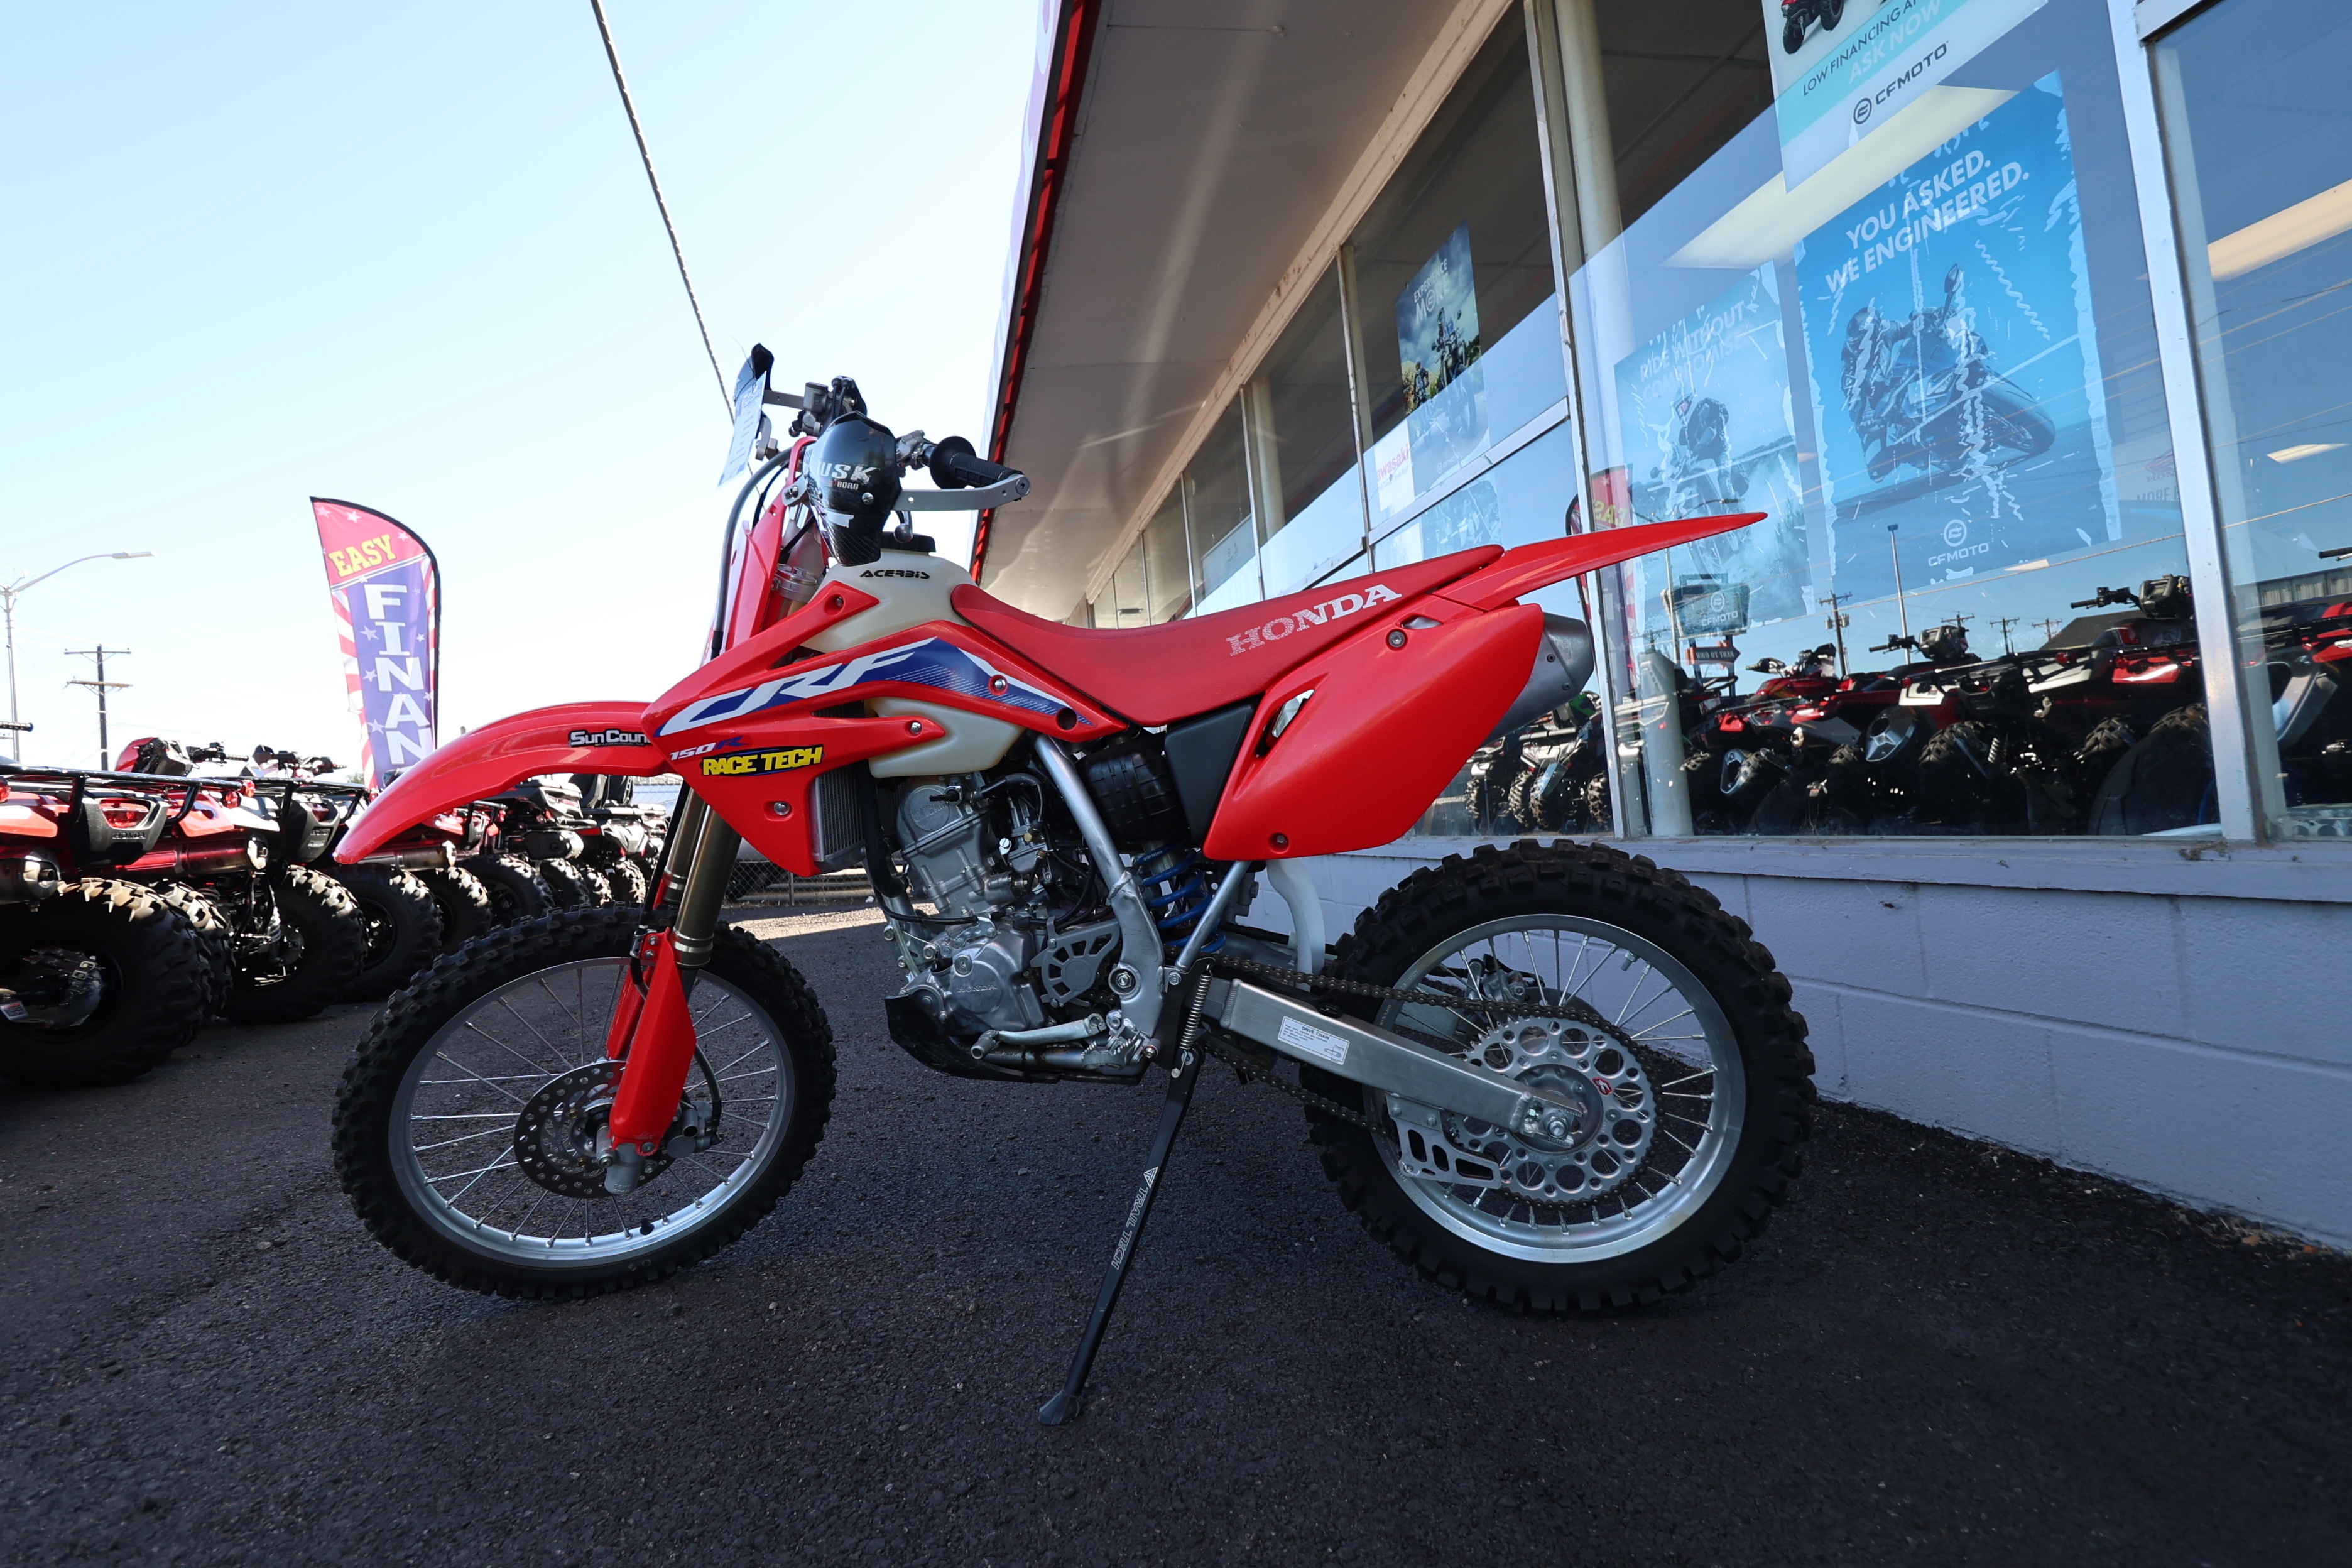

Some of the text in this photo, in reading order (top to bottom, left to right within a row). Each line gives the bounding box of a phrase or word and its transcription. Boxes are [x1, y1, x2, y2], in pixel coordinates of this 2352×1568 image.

[1803, 0, 1916, 96] LOW FINANCING A
[1849, 0, 1941, 84] ASK NOW
[1875, 43, 1947, 106] CFMOTO
[1846, 150, 1991, 249] YOU ASKED.
[1825, 162, 2030, 293] WE ENGINEERED.
[1413, 258, 1448, 303] EXPERIENCE
[1640, 300, 1745, 382] RIDE WITHOUT
[1376, 443, 1409, 481] awasaki
[2147, 471, 2176, 482] HON
[328, 534, 396, 579] EASY
[859, 570, 930, 579] ACERBIS
[1928, 542, 1989, 567] CFMOTO
[1226, 584, 1403, 656] HONDA
[1701, 610, 1738, 627] CFMOTO
[364, 584, 433, 765] FINAN
[660, 636, 937, 736] CRF
[606, 730, 651, 743] Coun
[669, 736, 748, 761] 150R
[702, 746, 823, 775] RACE TECH
[1301, 1025, 1315, 1035] DRIVE
[1315, 1031, 1330, 1040] CHAIN
[1111, 1187, 1149, 1270] TRAIL TECH
